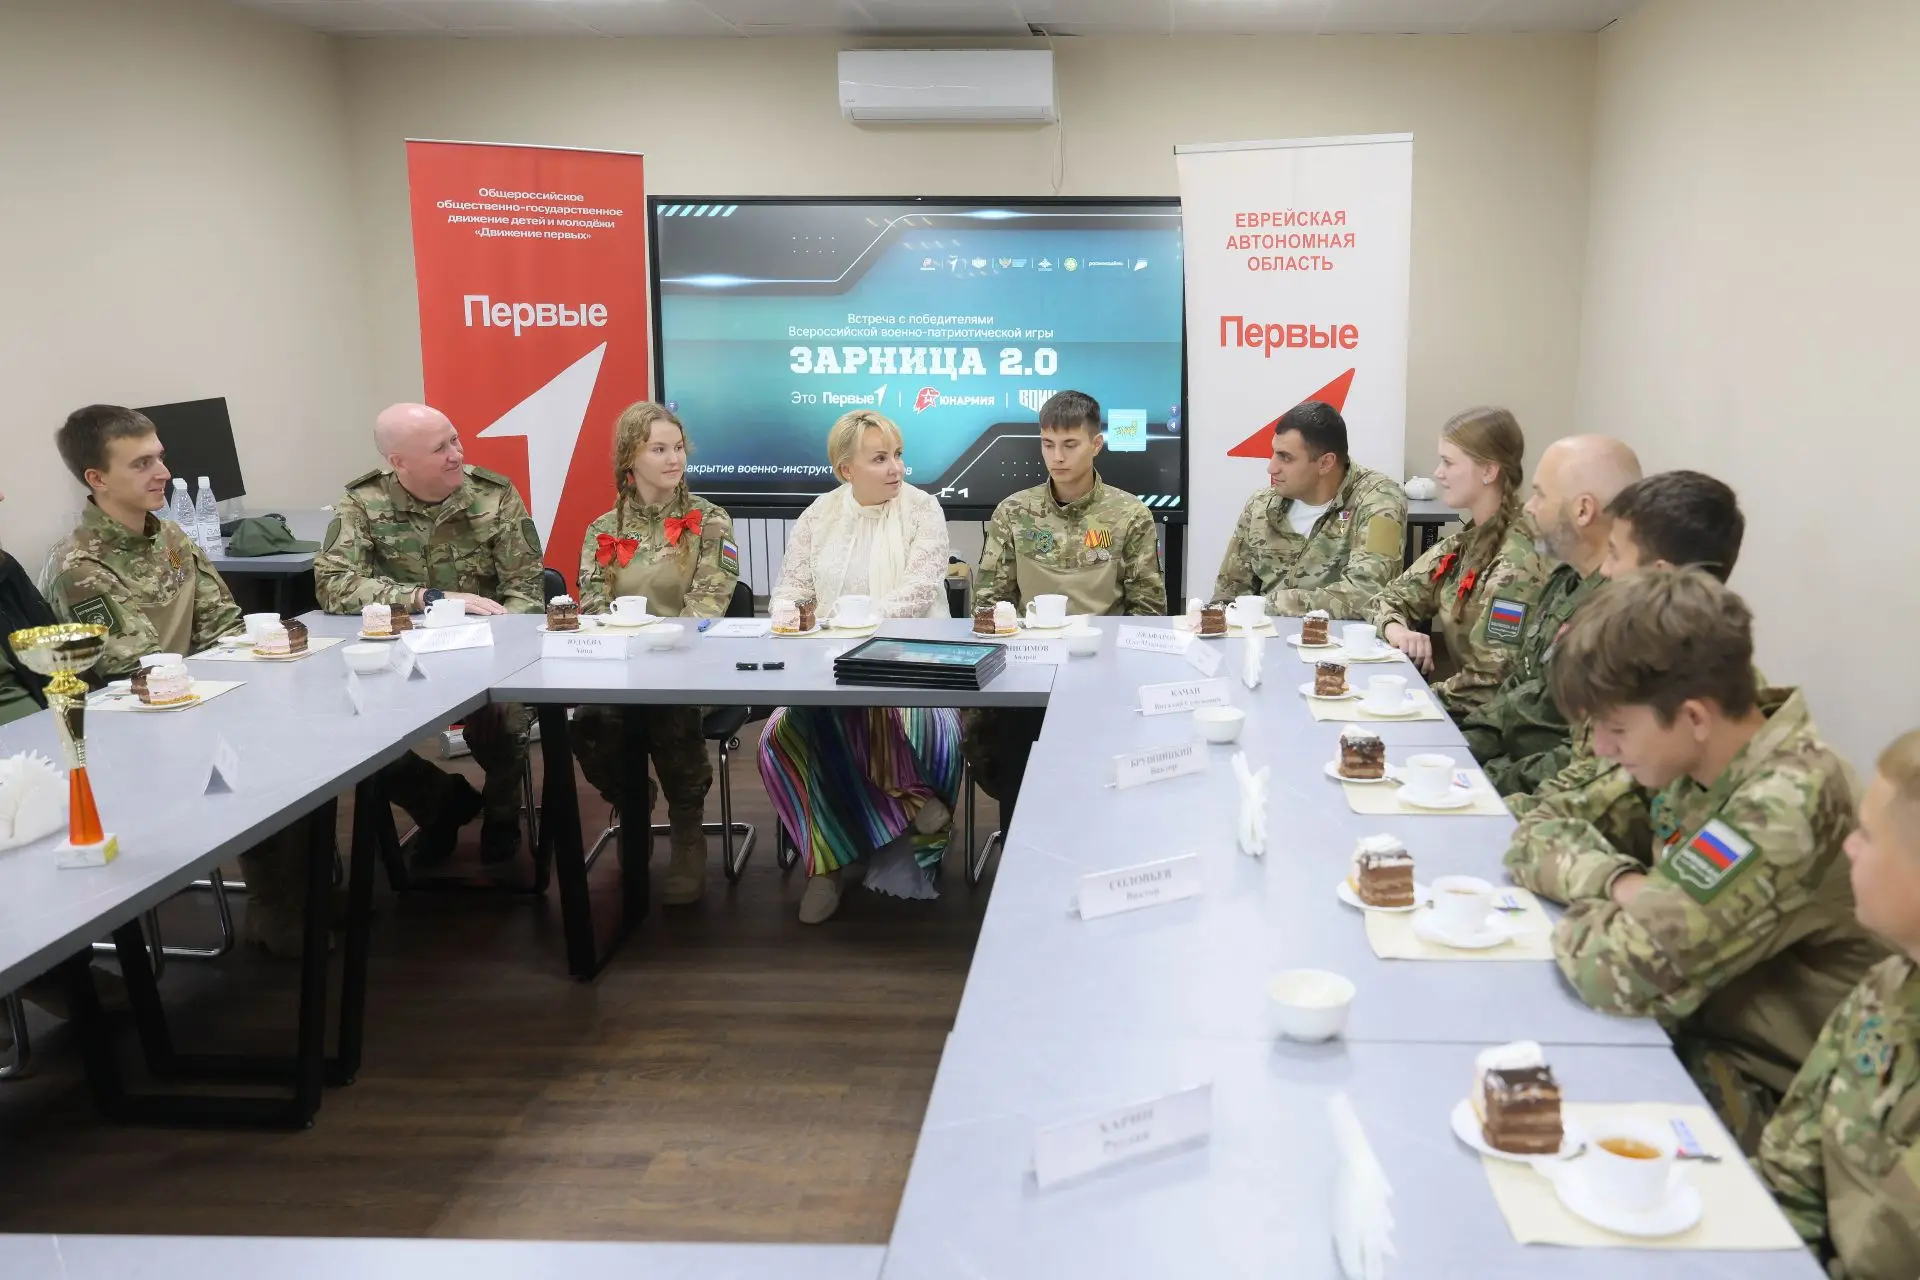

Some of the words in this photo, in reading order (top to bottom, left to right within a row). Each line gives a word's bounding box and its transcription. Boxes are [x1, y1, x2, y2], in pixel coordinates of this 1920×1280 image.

[479, 188, 584, 202] Общероссийское
[436, 200, 624, 217] общественно-государственное
[447, 213, 510, 225] движение
[511, 216, 546, 227] детей
[548, 218, 555, 226] и
[556, 218, 615, 229] молодёжи
[1235, 208, 1346, 228] ЕВРЕЙСКАЯ
[475, 228, 542, 239] «Движение
[543, 230, 592, 241] первых»
[1226, 232, 1356, 250] АВТОНОМНАЯ
[1247, 256, 1334, 272] ОБЛАСТЬ
[463, 294, 608, 337] Первые
[847, 313, 896, 325] Встреча
[898, 316, 906, 324] с
[908, 313, 994, 325] победителями
[788, 326, 878, 339] Всероссийской
[881, 327, 1022, 340] военно-патриотической
[1025, 329, 1054, 340] игры
[1220, 315, 1359, 358] Первые
[789, 346, 987, 380] ЗАРНИЦА
[999, 347, 1058, 376] 2.0
[791, 391, 817, 404] Это
[822, 391, 875, 407] Первые
[939, 395, 995, 406] ЮНАРМИЯ
[684, 464, 735, 476] акрытие
